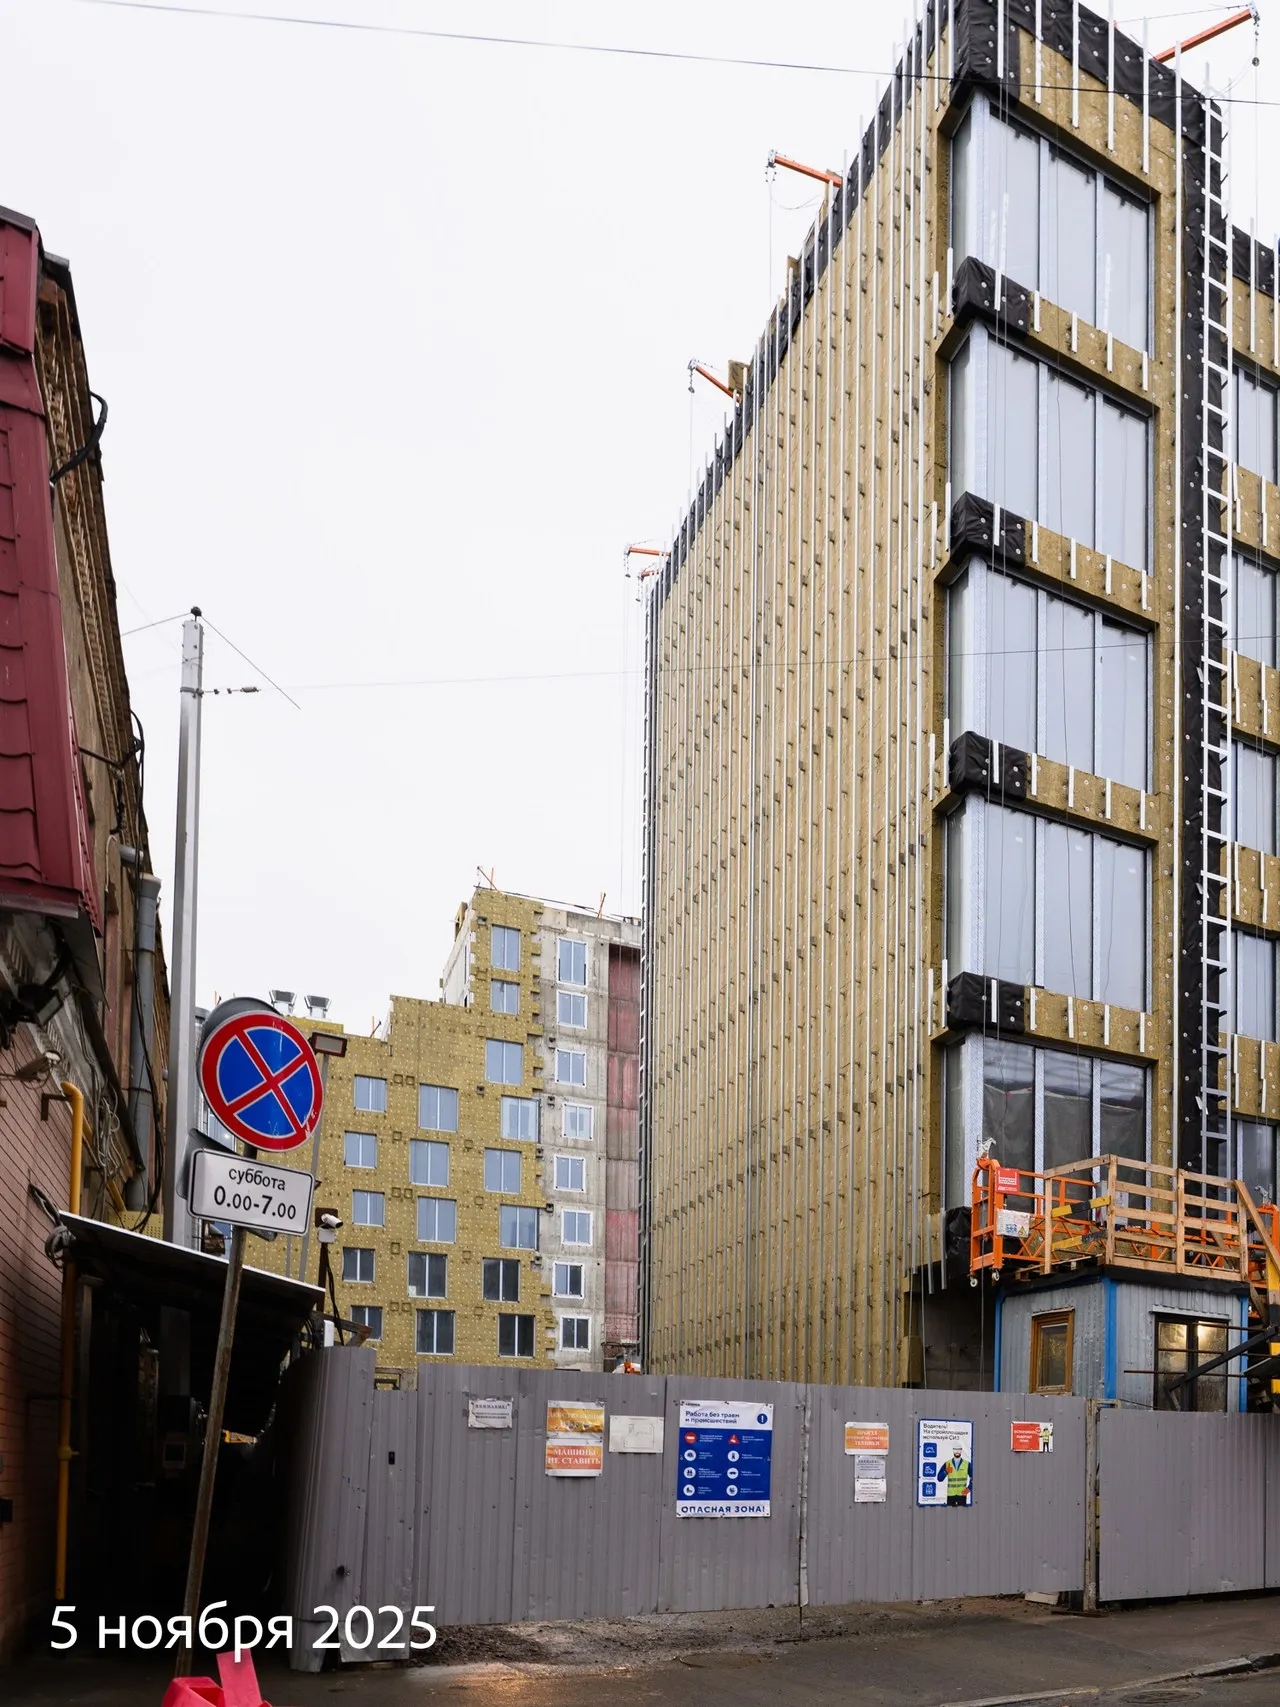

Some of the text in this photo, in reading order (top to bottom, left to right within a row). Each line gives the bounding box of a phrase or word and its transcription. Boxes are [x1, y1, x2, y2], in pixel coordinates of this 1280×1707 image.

[228, 1167, 286, 1191] суббота
[213, 1185, 297, 1220] 0.00-7.00
[553, 1448, 596, 1456] МАШИНЫ
[561, 1457, 601, 1465] СТАВИТЬ
[734, 1505, 765, 1513] ЗОНА!
